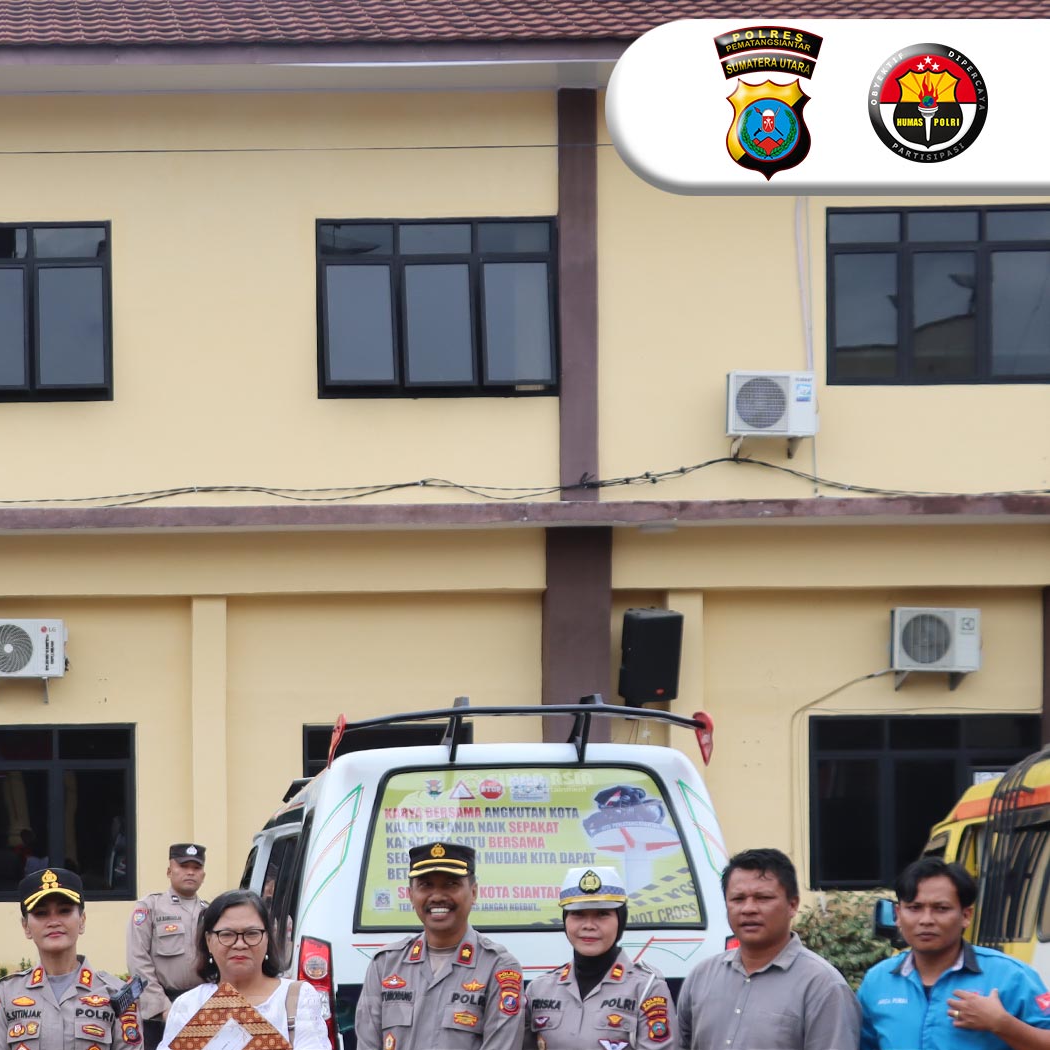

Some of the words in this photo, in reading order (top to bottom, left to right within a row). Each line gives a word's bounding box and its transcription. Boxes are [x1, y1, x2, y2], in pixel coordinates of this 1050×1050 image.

[425, 807, 482, 819] BERSAMA
[484, 806, 547, 819] ANGKUTAN
[549, 807, 580, 819] KOTA
[478, 822, 506, 833] NAIK
[508, 821, 560, 834] SEPAKAT
[488, 836, 546, 849] BERSAMA
[386, 852, 410, 864] SEG
[484, 852, 528, 864] MUDAH
[531, 852, 558, 864] KITA
[560, 852, 596, 865] DAPAT
[479, 886, 510, 899] KOTA
[657, 902, 698, 922] CROSS
[599, 996, 636, 1012] POLRI
[75, 1007, 114, 1023] POLRI
